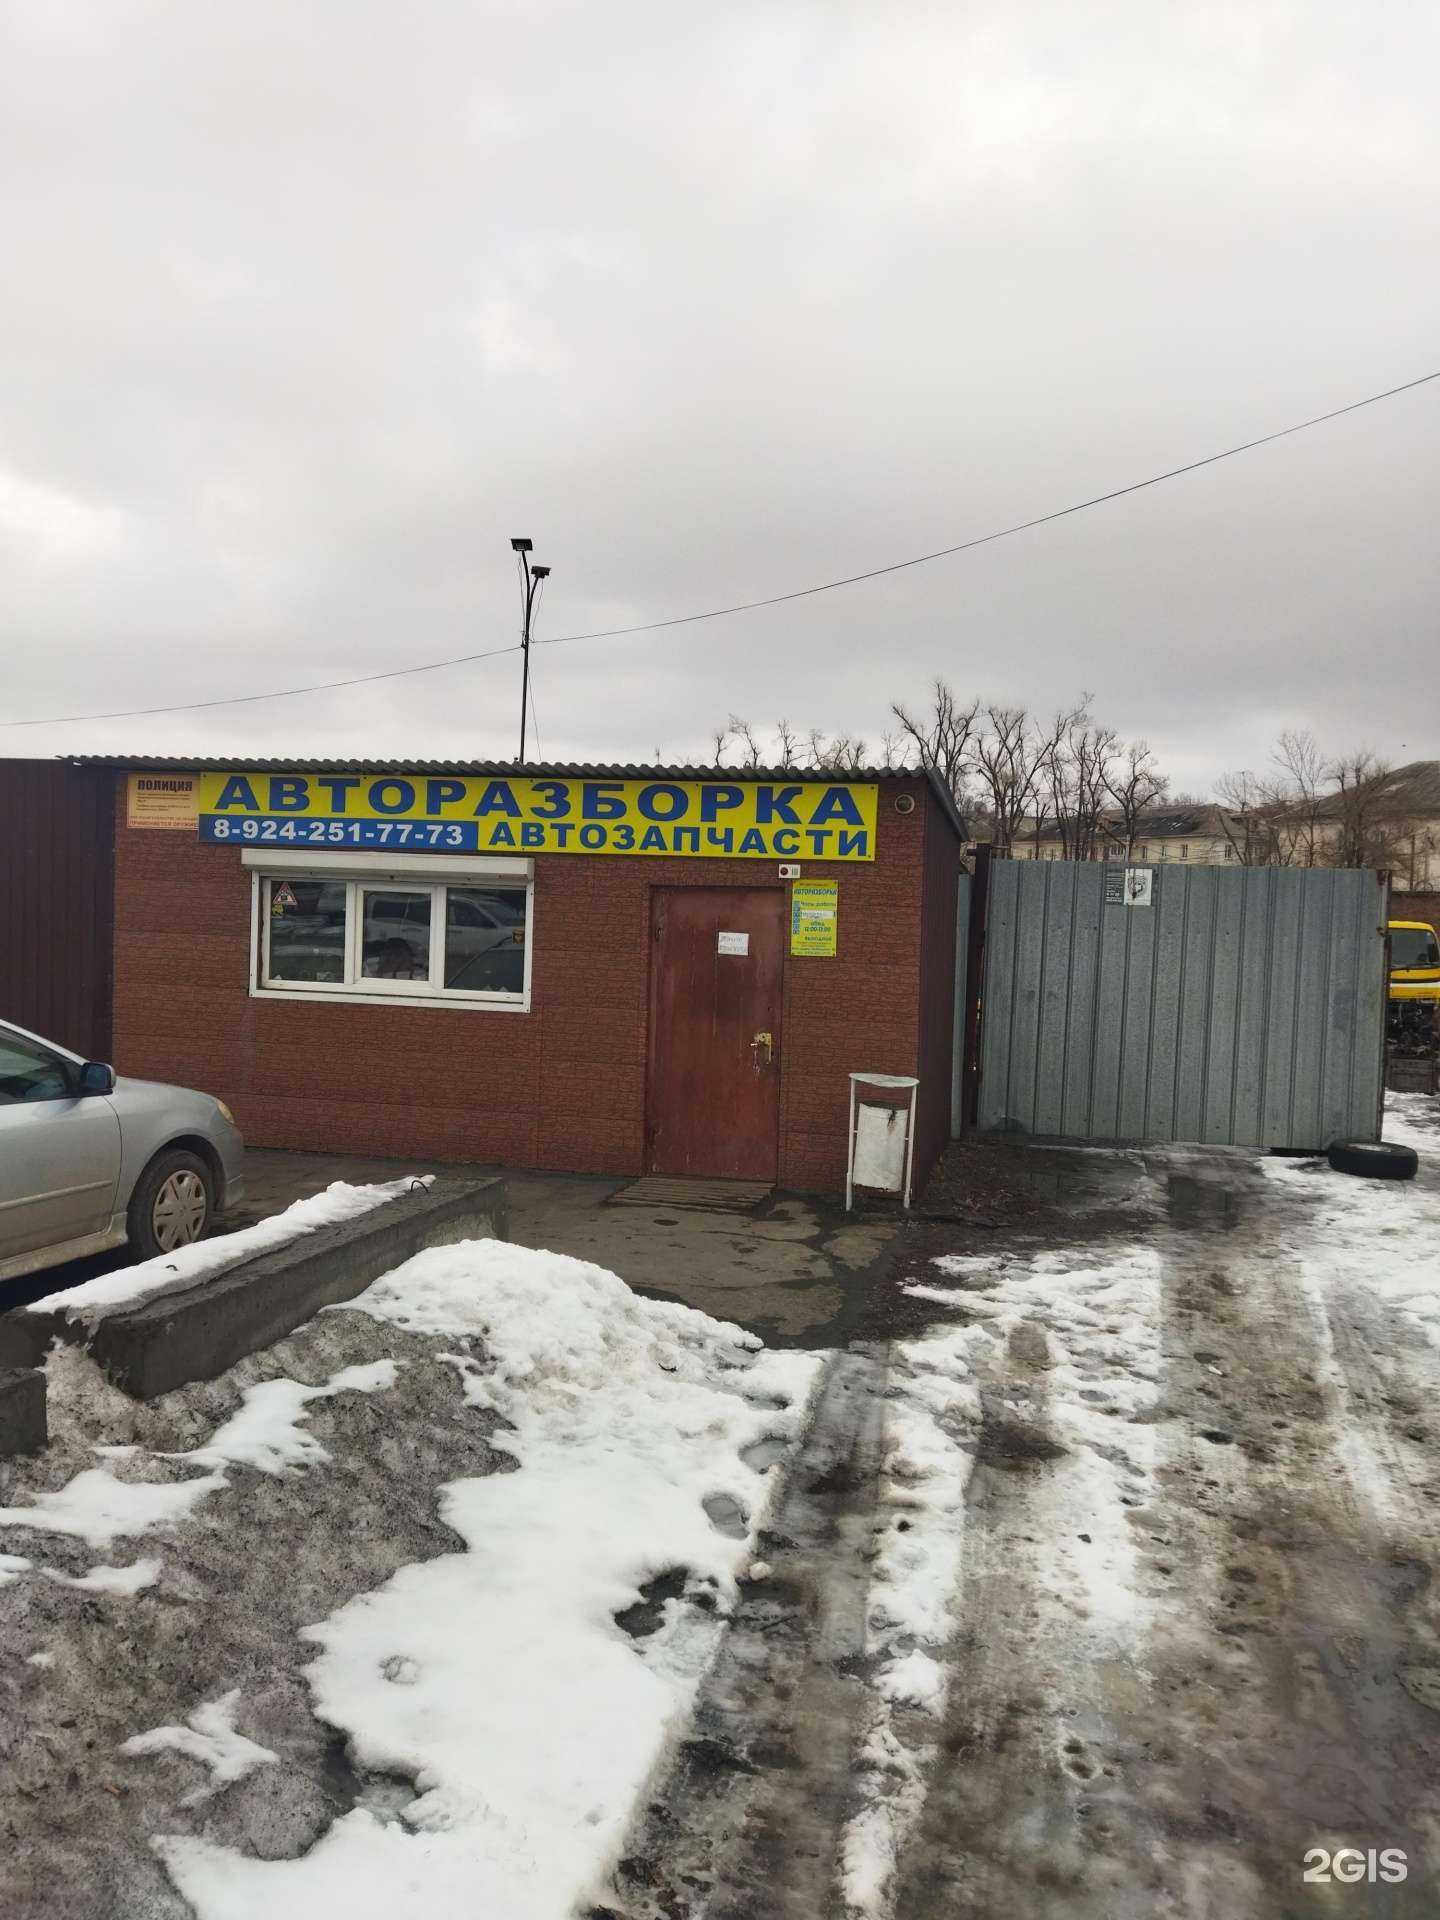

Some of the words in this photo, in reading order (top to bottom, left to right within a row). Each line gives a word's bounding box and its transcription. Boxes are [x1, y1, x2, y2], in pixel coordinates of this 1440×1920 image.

[137, 780, 192, 792] ПОЛИЦИЯ
[214, 776, 864, 826] АВТОРАЗБОРКА
[213, 818, 463, 845] 8-924-251-77-73
[488, 821, 869, 856] АВТОЗАПЧАСТИ
